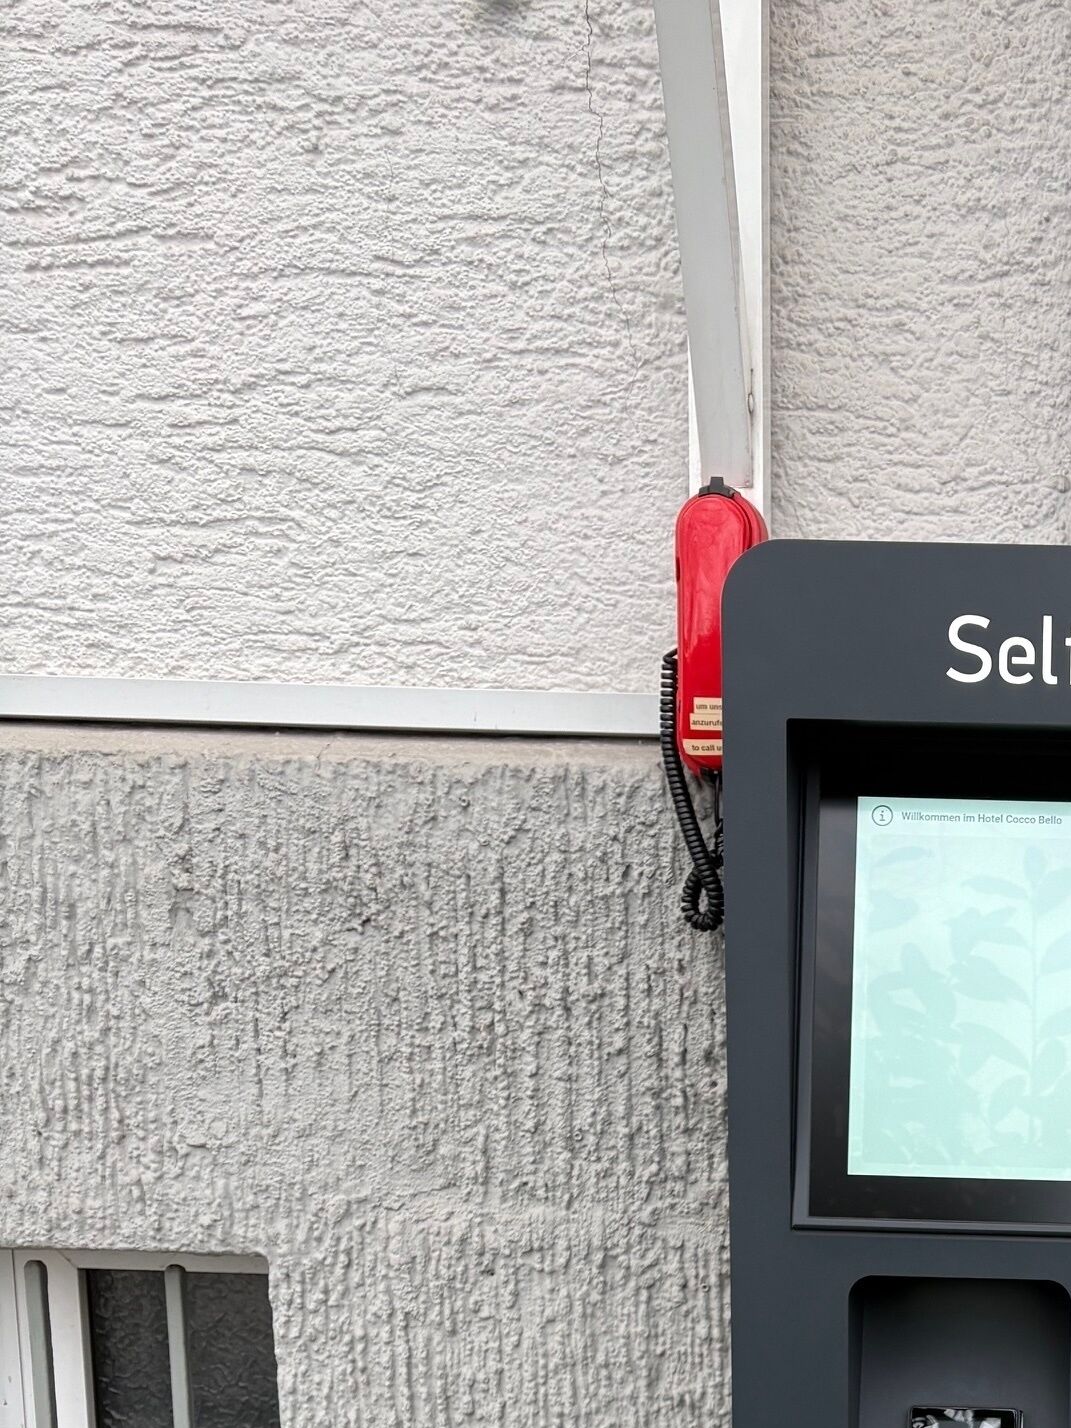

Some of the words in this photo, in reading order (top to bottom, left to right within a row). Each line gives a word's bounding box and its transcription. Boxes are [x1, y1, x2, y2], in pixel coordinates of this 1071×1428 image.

[901, 811, 960, 822] Willkommen
[963, 813, 975, 823] im
[978, 814, 1004, 823] Hotel
[1006, 815, 1036, 824] Cocco
[1038, 815, 1062, 825] Bello
